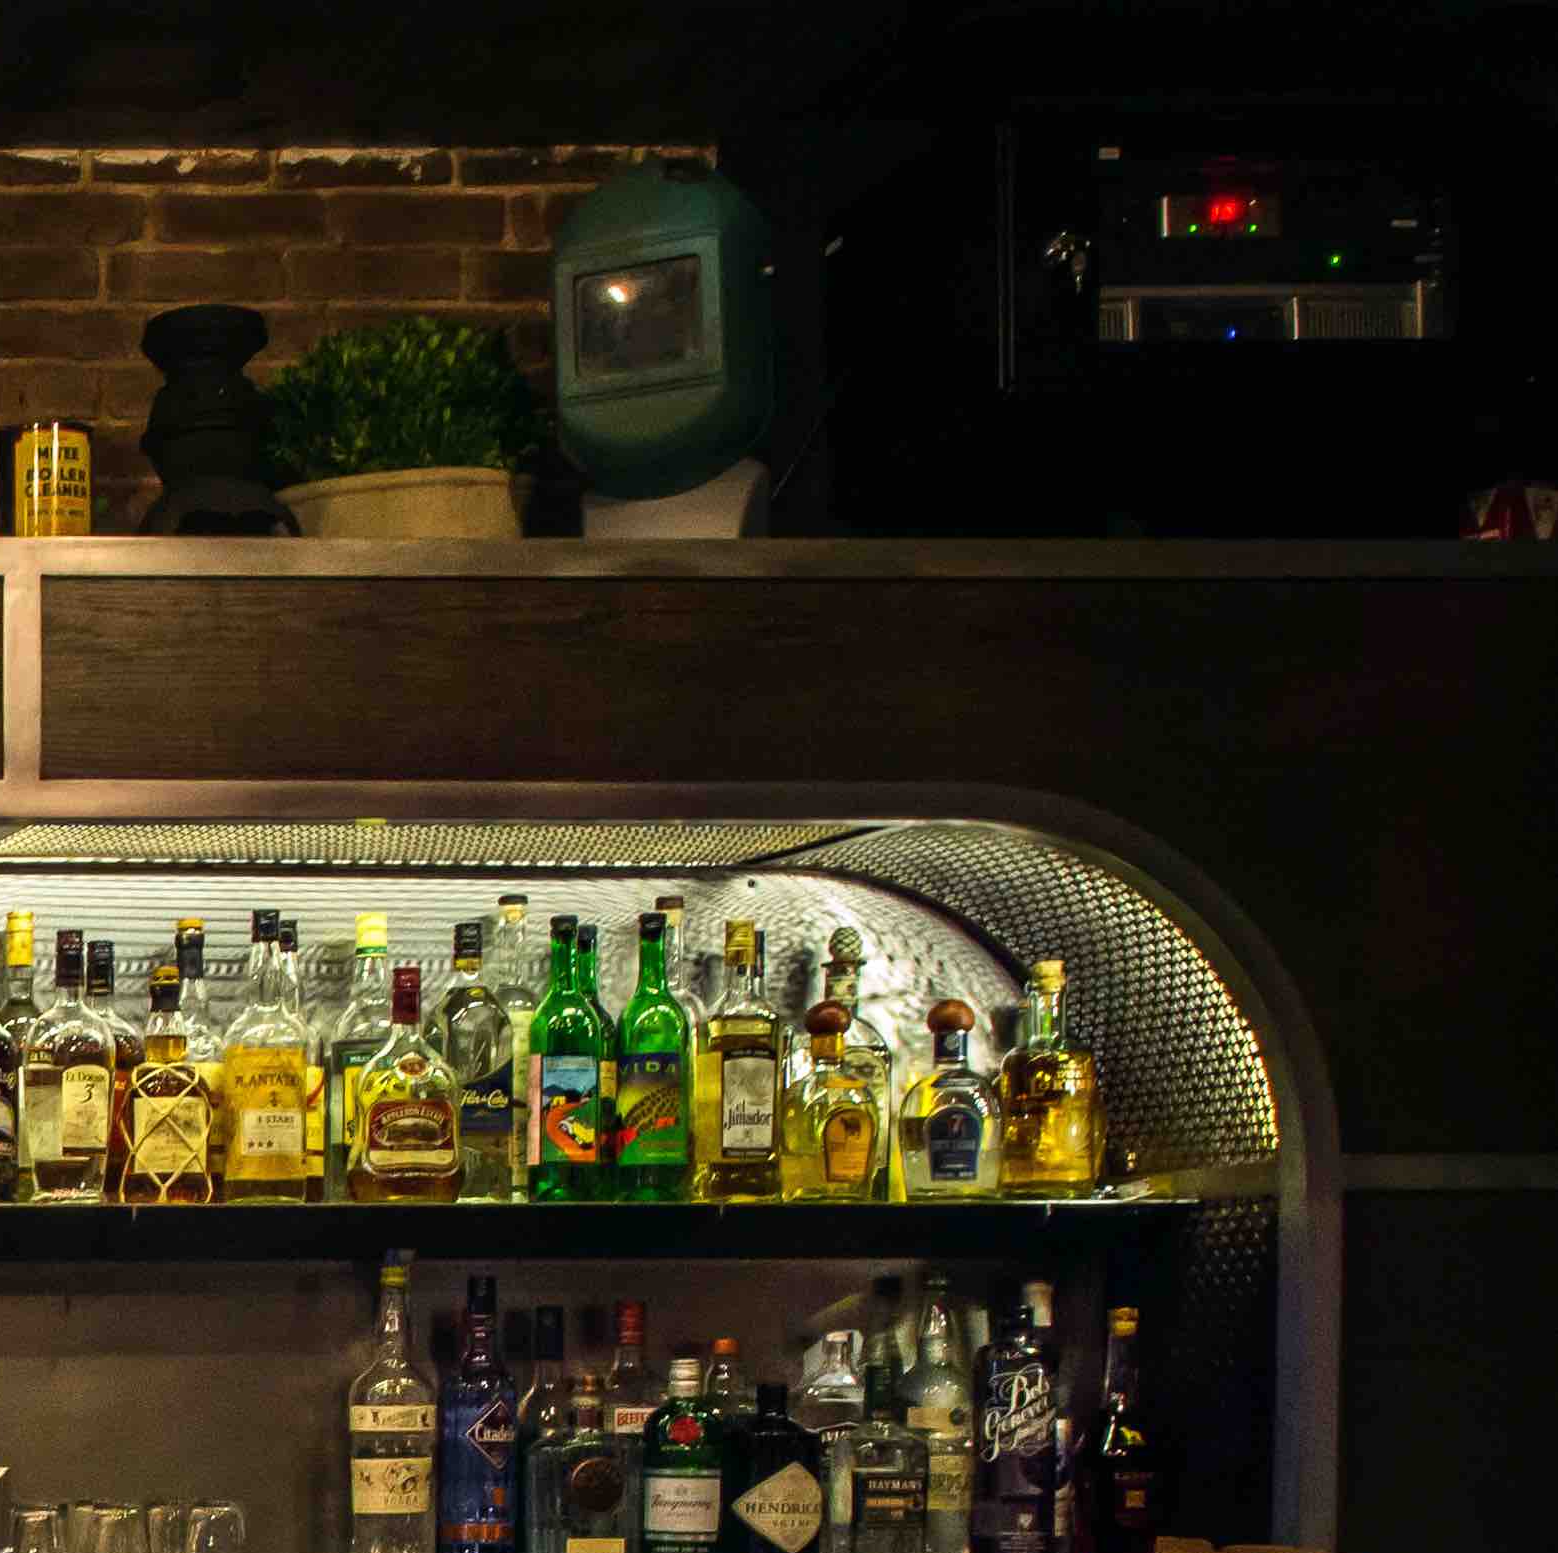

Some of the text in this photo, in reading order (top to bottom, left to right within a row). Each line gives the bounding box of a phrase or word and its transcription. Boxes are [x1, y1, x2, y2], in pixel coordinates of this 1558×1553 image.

[26, 467, 87, 482] BOLER
[25, 482, 88, 497] CEANER
[79, 1082, 95, 1104] 3
